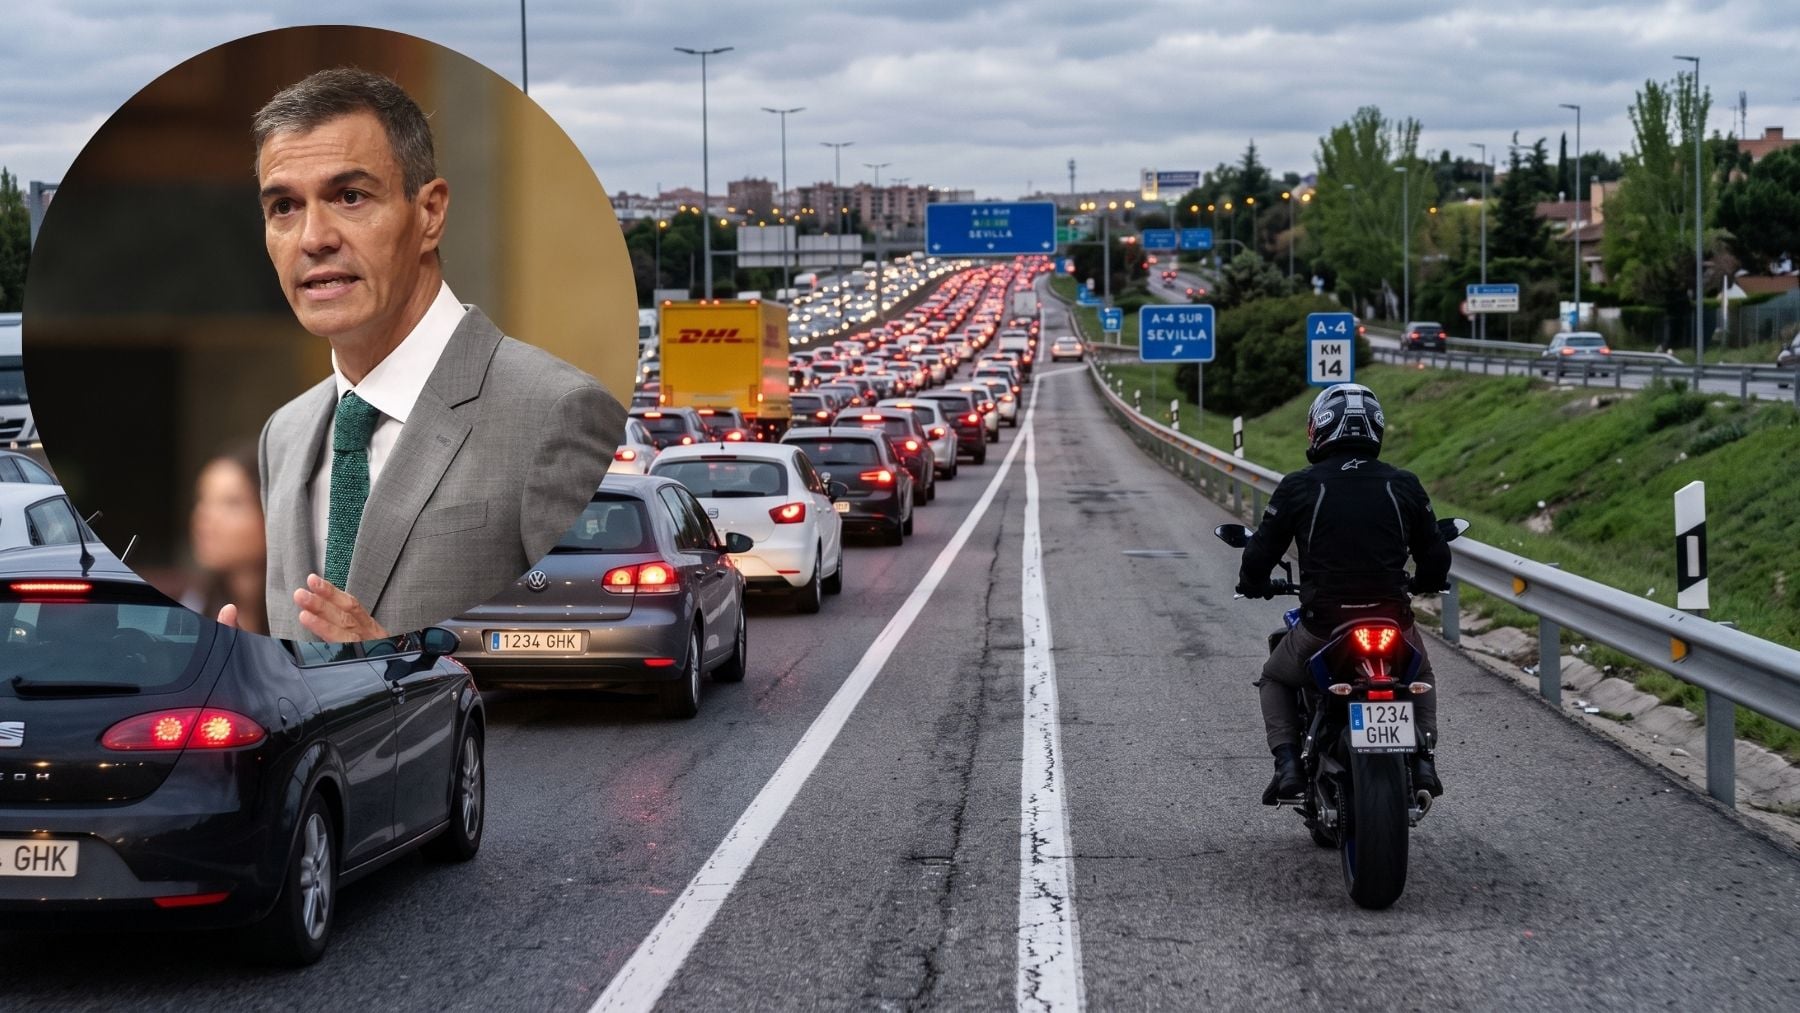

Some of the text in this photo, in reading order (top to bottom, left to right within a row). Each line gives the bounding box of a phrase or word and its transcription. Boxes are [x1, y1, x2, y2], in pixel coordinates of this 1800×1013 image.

[1151, 313, 1203, 323] A-4 SUR
[1147, 329, 1207, 340] SEVILLA
[1315, 320, 1347, 335] A-4
[679, 329, 742, 344] DHL
[1320, 344, 1341, 355] KM
[1318, 359, 1343, 377] 14
[504, 634, 576, 648] 1234 GHK
[1366, 705, 1409, 723] 1234
[1366, 726, 1400, 743] GHK
[14, 845, 68, 871] GHK
